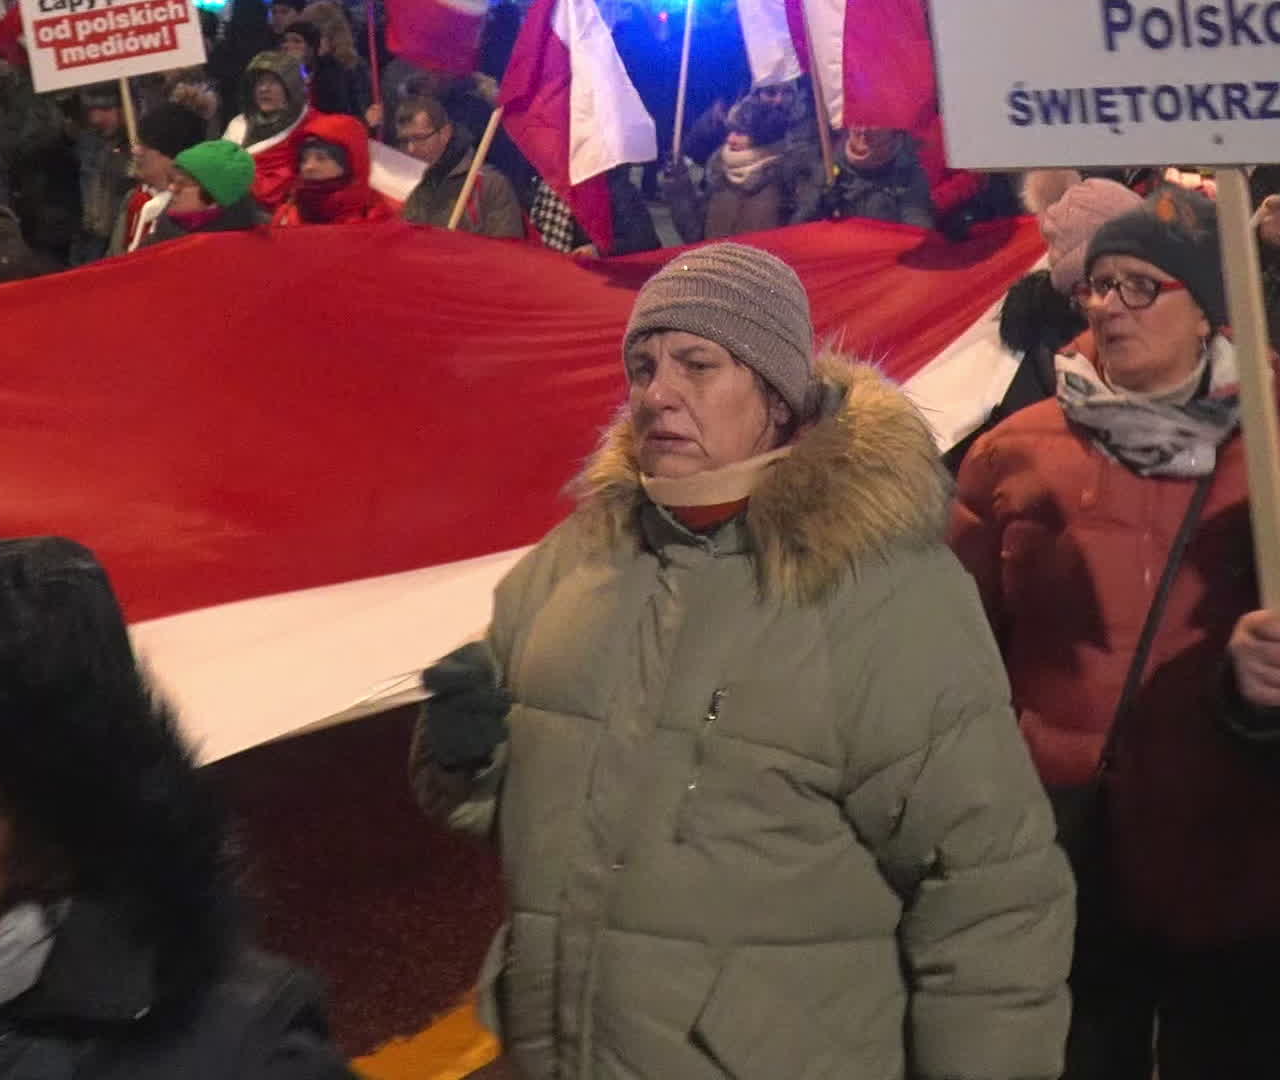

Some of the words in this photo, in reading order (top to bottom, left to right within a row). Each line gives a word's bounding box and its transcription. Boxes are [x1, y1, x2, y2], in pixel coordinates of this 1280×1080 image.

[38, 20, 71, 42] od
[74, 1, 186, 41] polskich
[62, 27, 172, 65] mediów!
